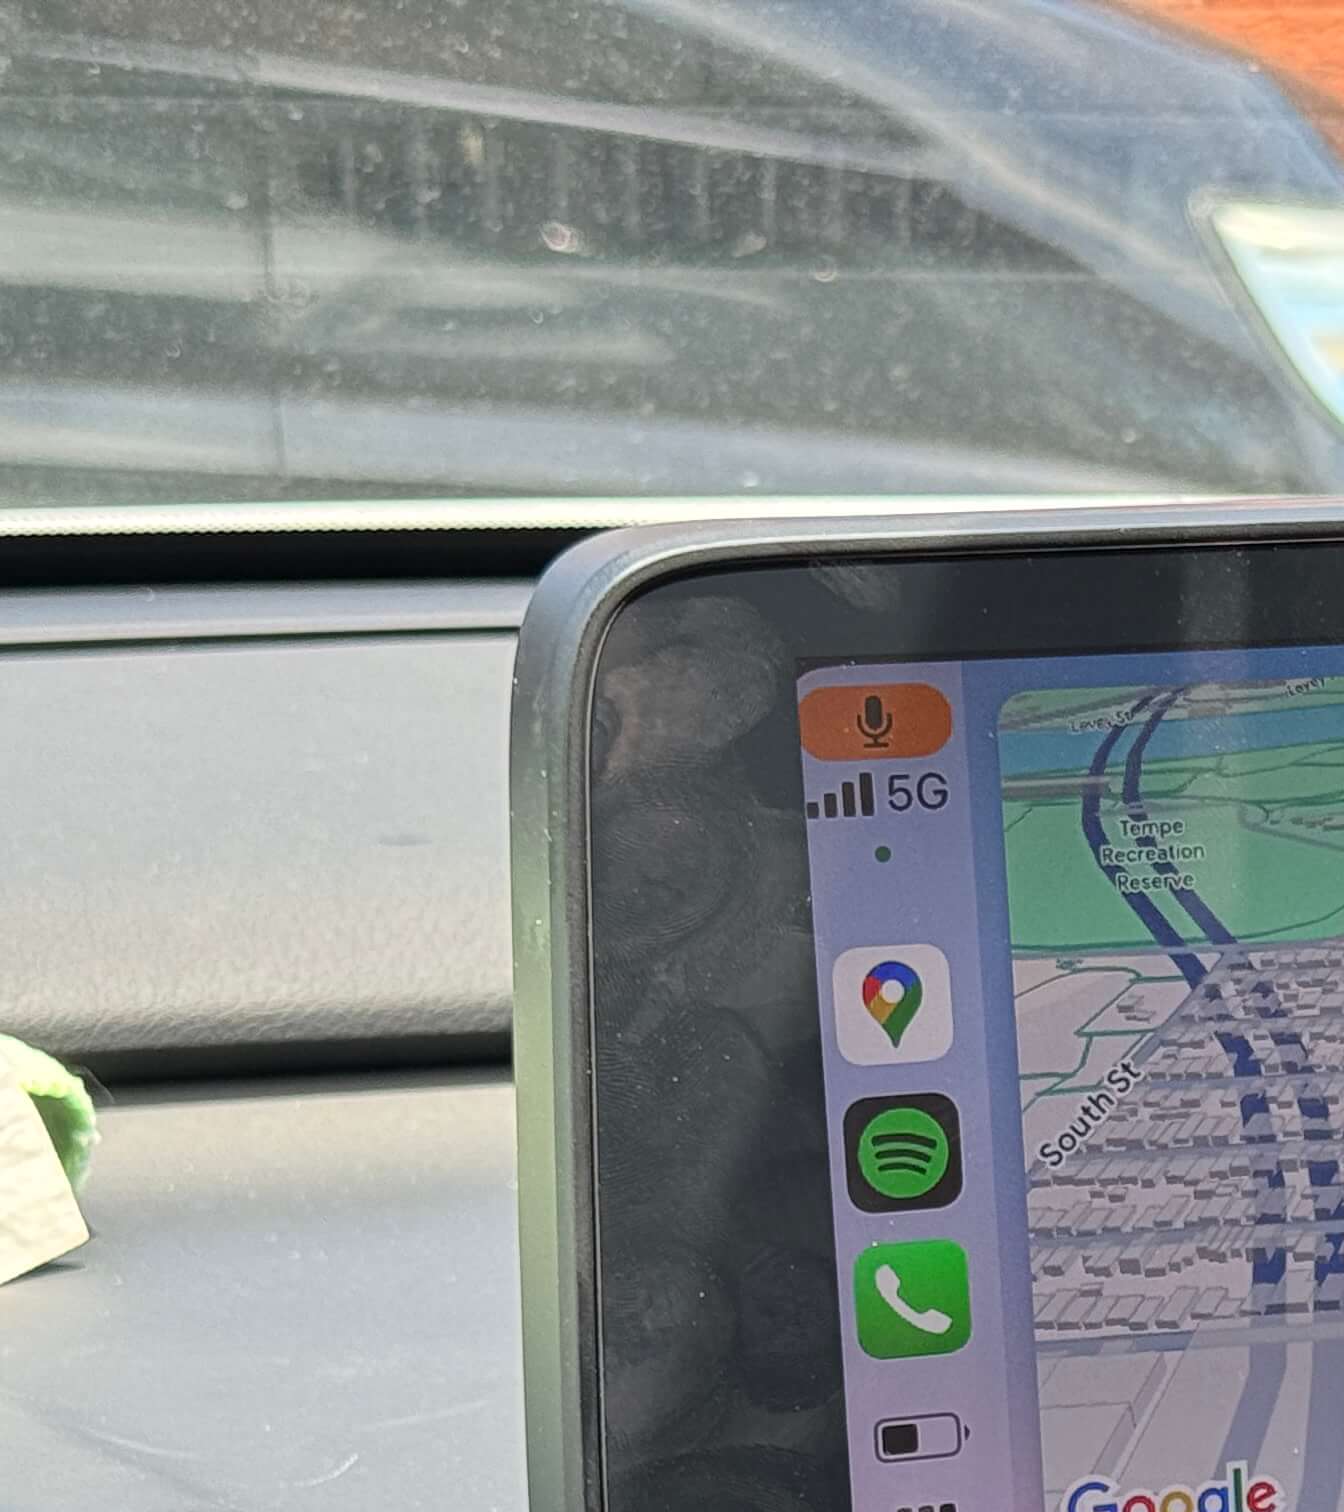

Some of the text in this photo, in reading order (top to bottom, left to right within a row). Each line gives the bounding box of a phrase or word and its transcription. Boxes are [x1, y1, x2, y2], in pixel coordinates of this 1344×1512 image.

[888, 772, 948, 811] 5G
[1120, 820, 1184, 839] Tempe
[1102, 845, 1205, 863] Recreation
[1117, 874, 1195, 891] Reserve
[1039, 1062, 1141, 1167] South St
